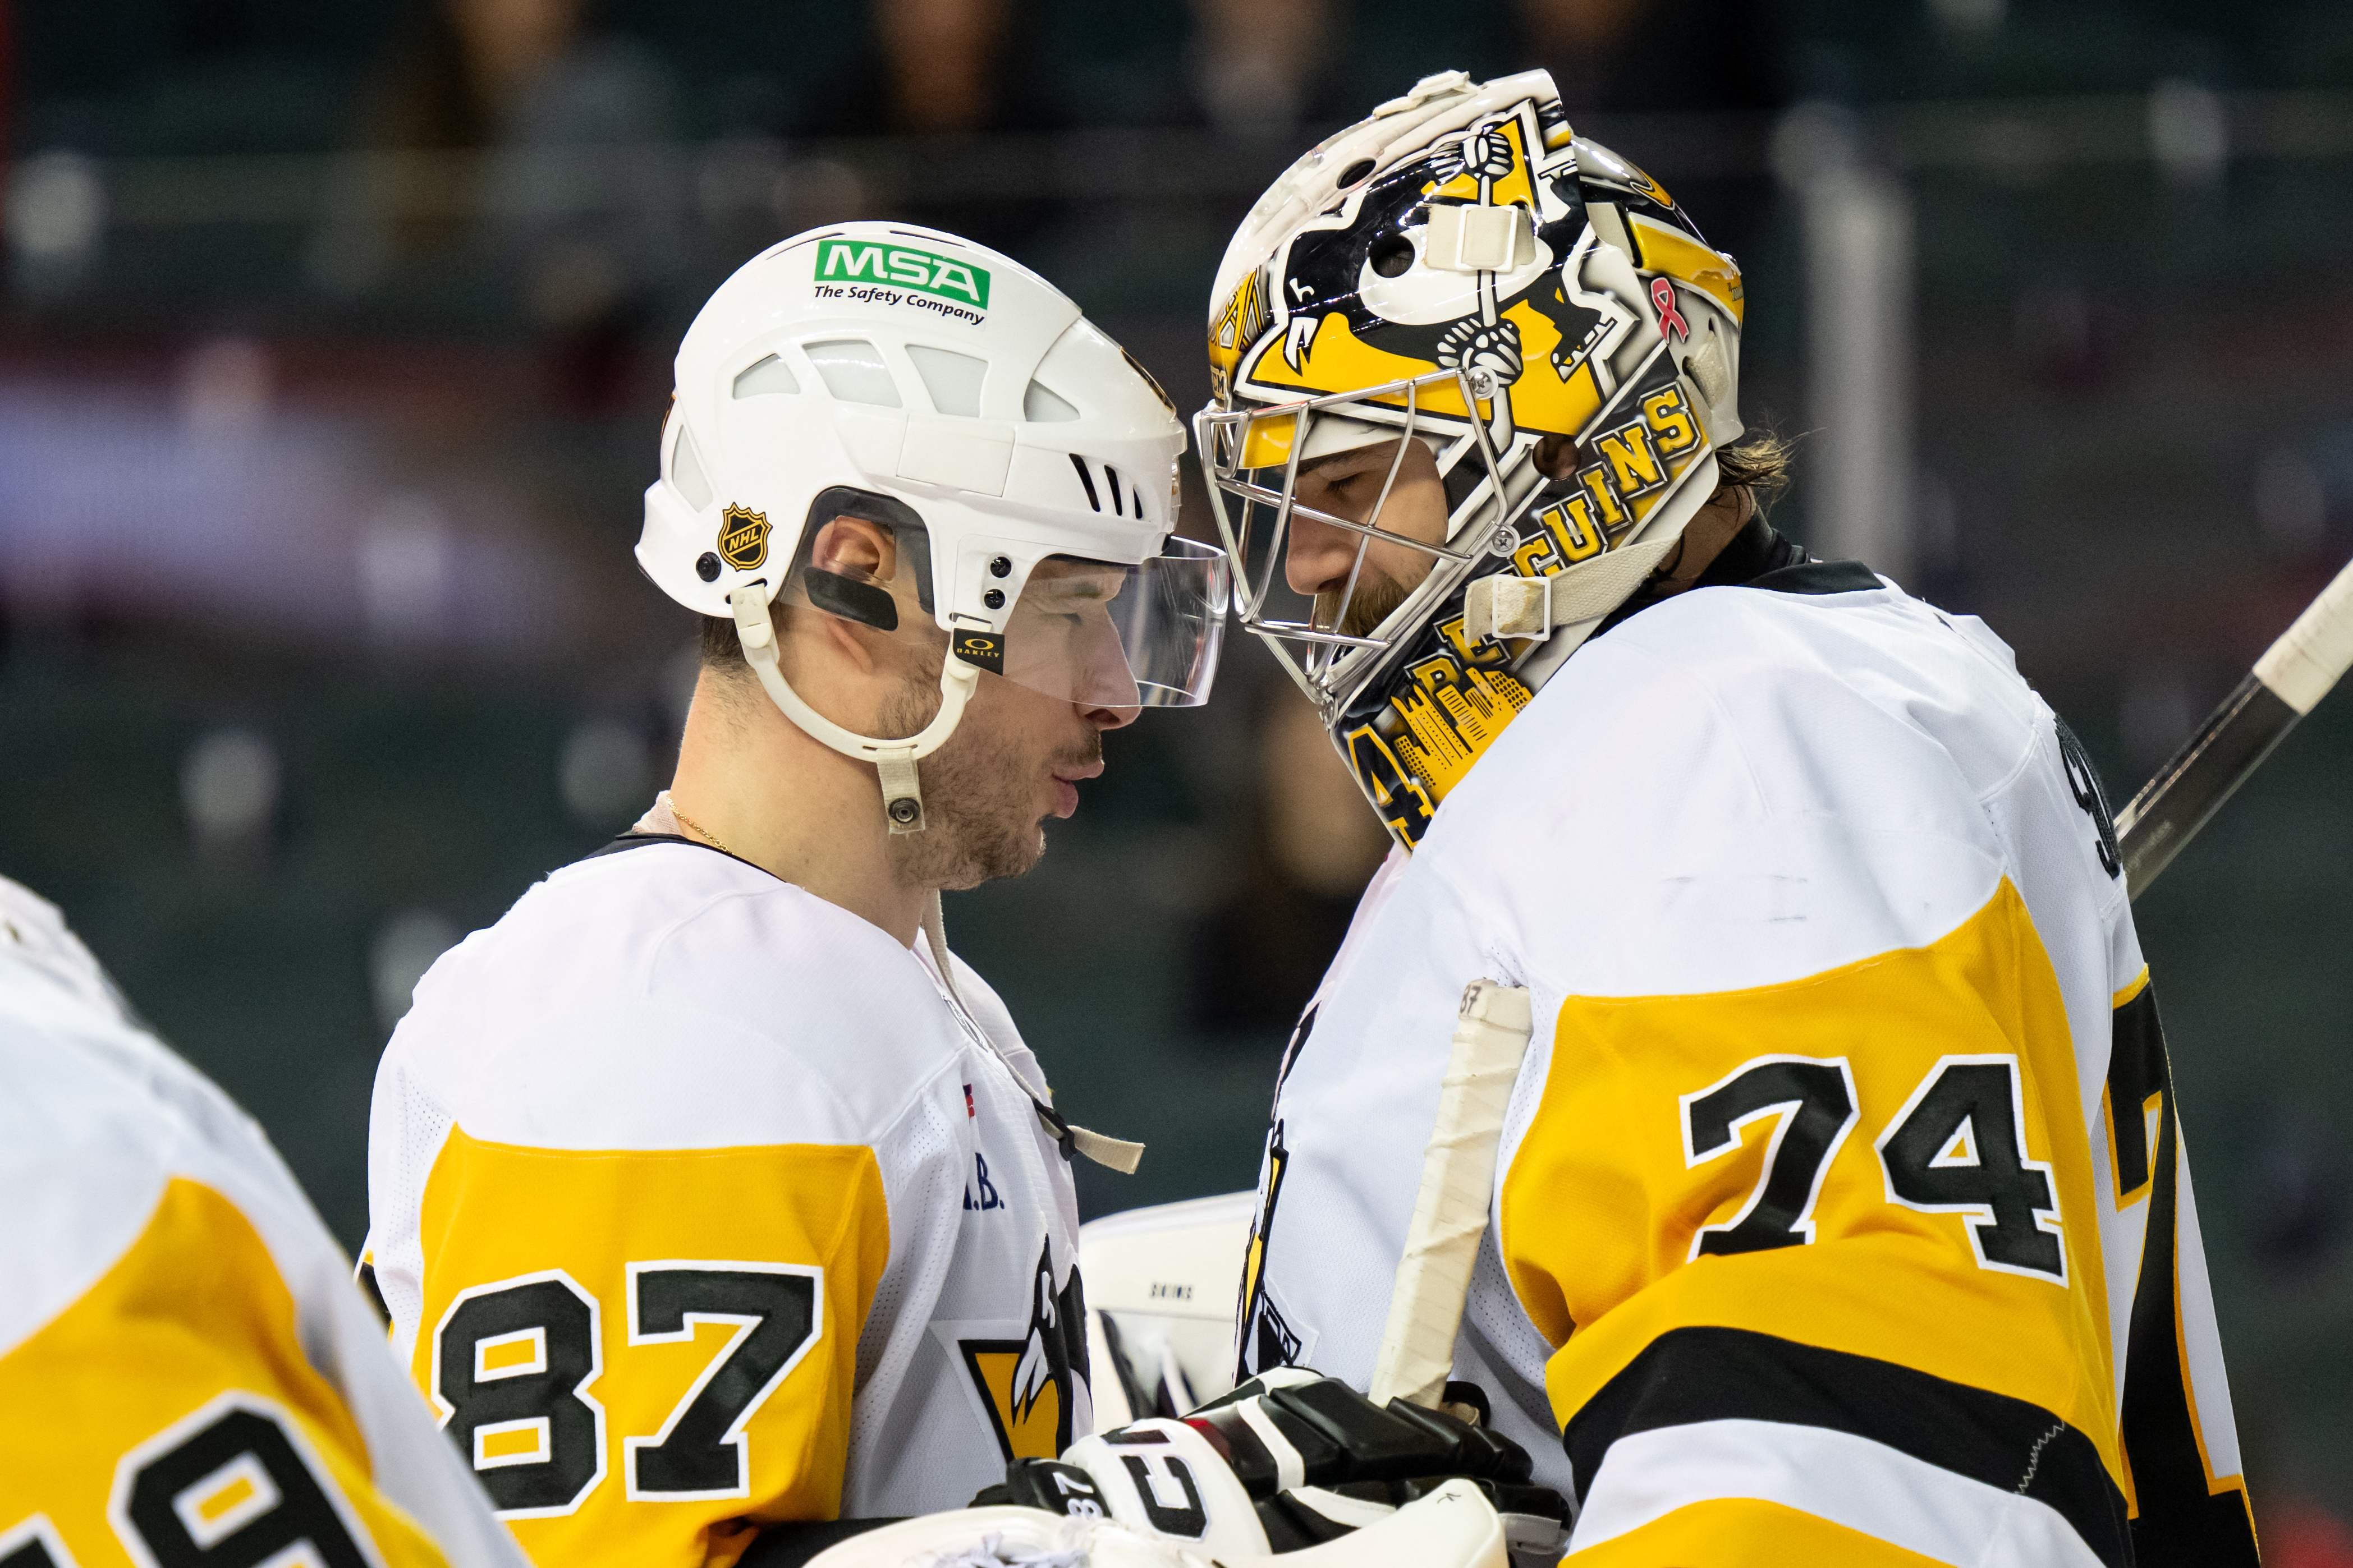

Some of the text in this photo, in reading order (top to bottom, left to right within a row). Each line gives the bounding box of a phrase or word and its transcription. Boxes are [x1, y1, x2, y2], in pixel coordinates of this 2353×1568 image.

[823, 245, 980, 302] MSA
[814, 285, 985, 326] The Safety Company
[728, 527, 759, 552] NHL
[956, 648, 1000, 657] OAKLEY
[1678, 1053, 2070, 1289] 74
[431, 1258, 824, 1521] 87
[1052, 1471, 1104, 1520] 87
